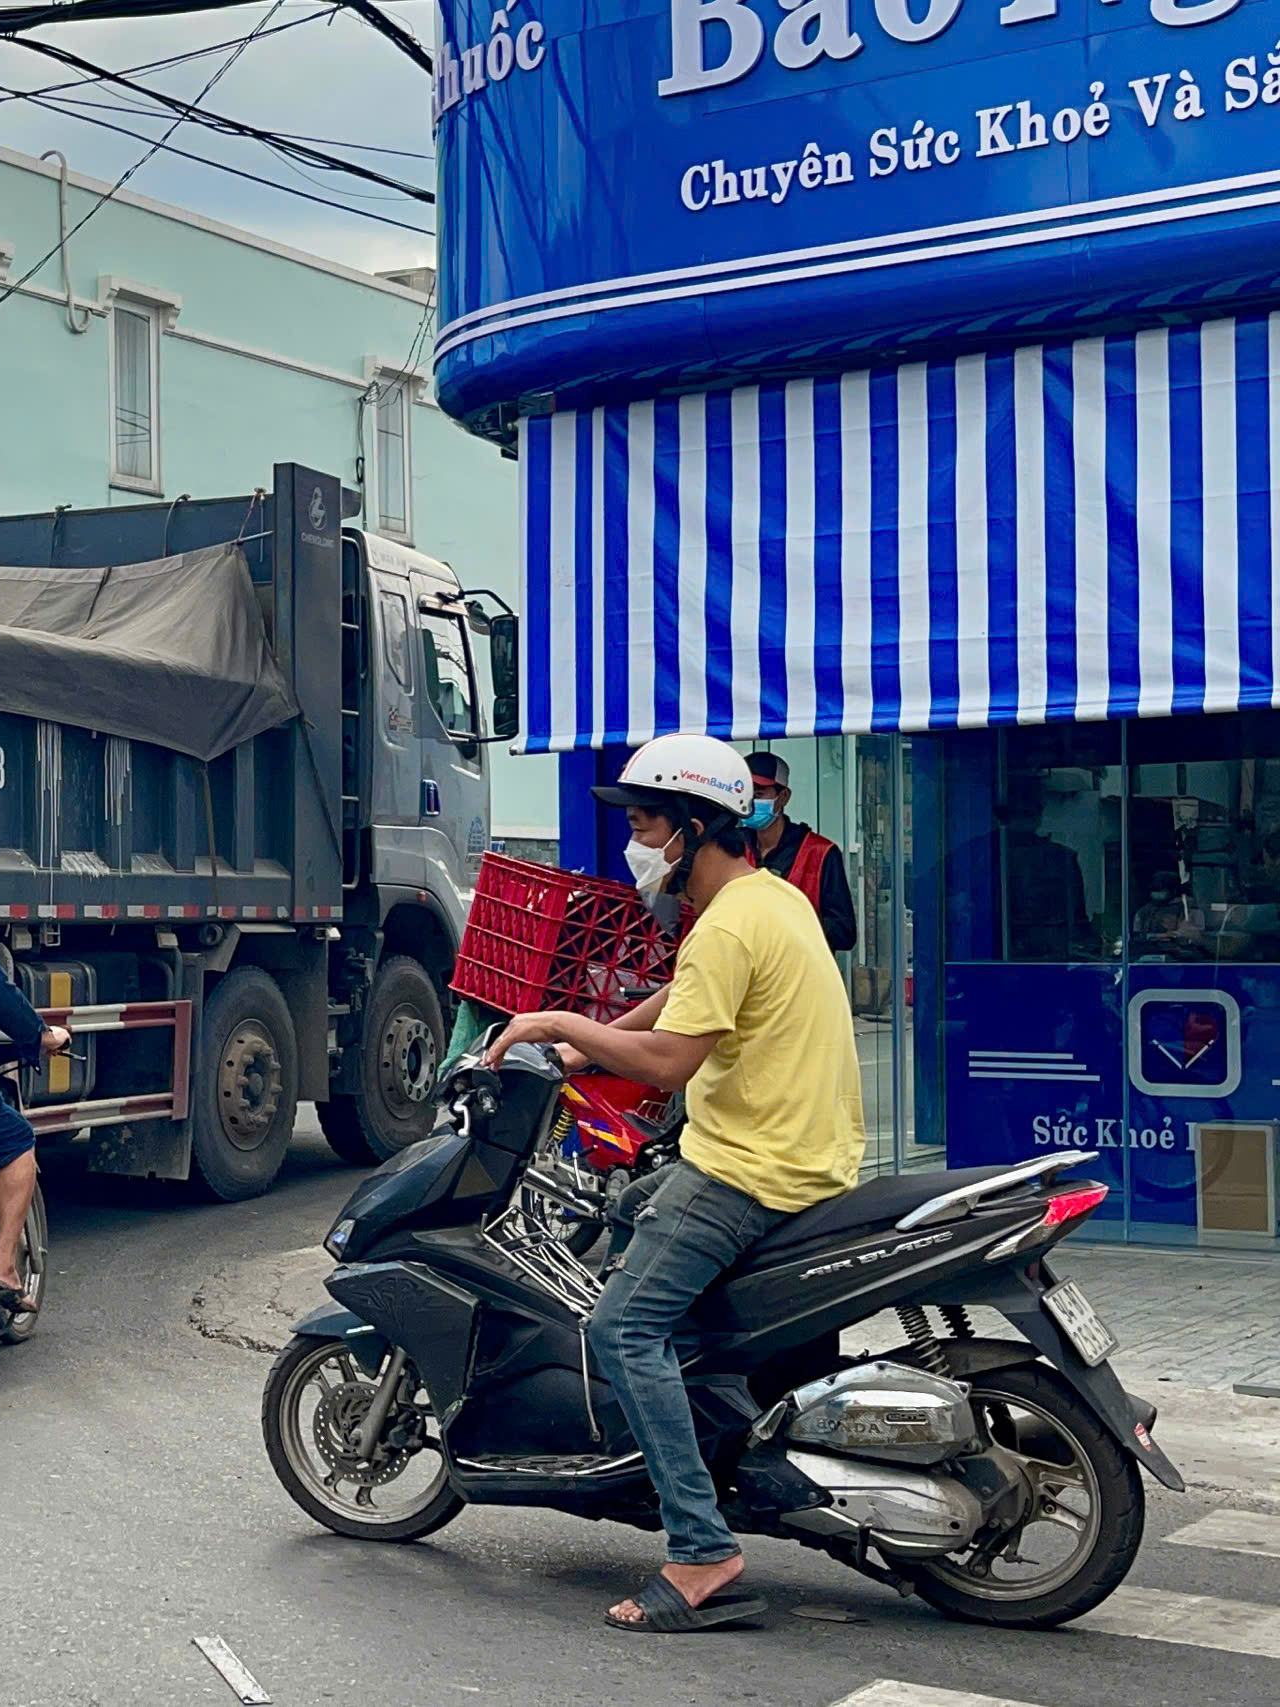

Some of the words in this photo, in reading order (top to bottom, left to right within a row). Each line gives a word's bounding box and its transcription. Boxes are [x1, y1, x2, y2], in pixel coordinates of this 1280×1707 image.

[680, 142, 855, 211] Chuyên
[869, 119, 960, 178] Sức
[975, 80, 1111, 158] Khoẻ
[1128, 69, 1206, 128] Và
[680, 768, 734, 793] VietinBank
[1032, 1116, 1088, 1146] Sức
[1095, 1116, 1175, 1149] Khoẻ
[798, 1258, 854, 1281] AIR
[856, 1230, 954, 1265] BLADE
[816, 1415, 882, 1434] HONDA
